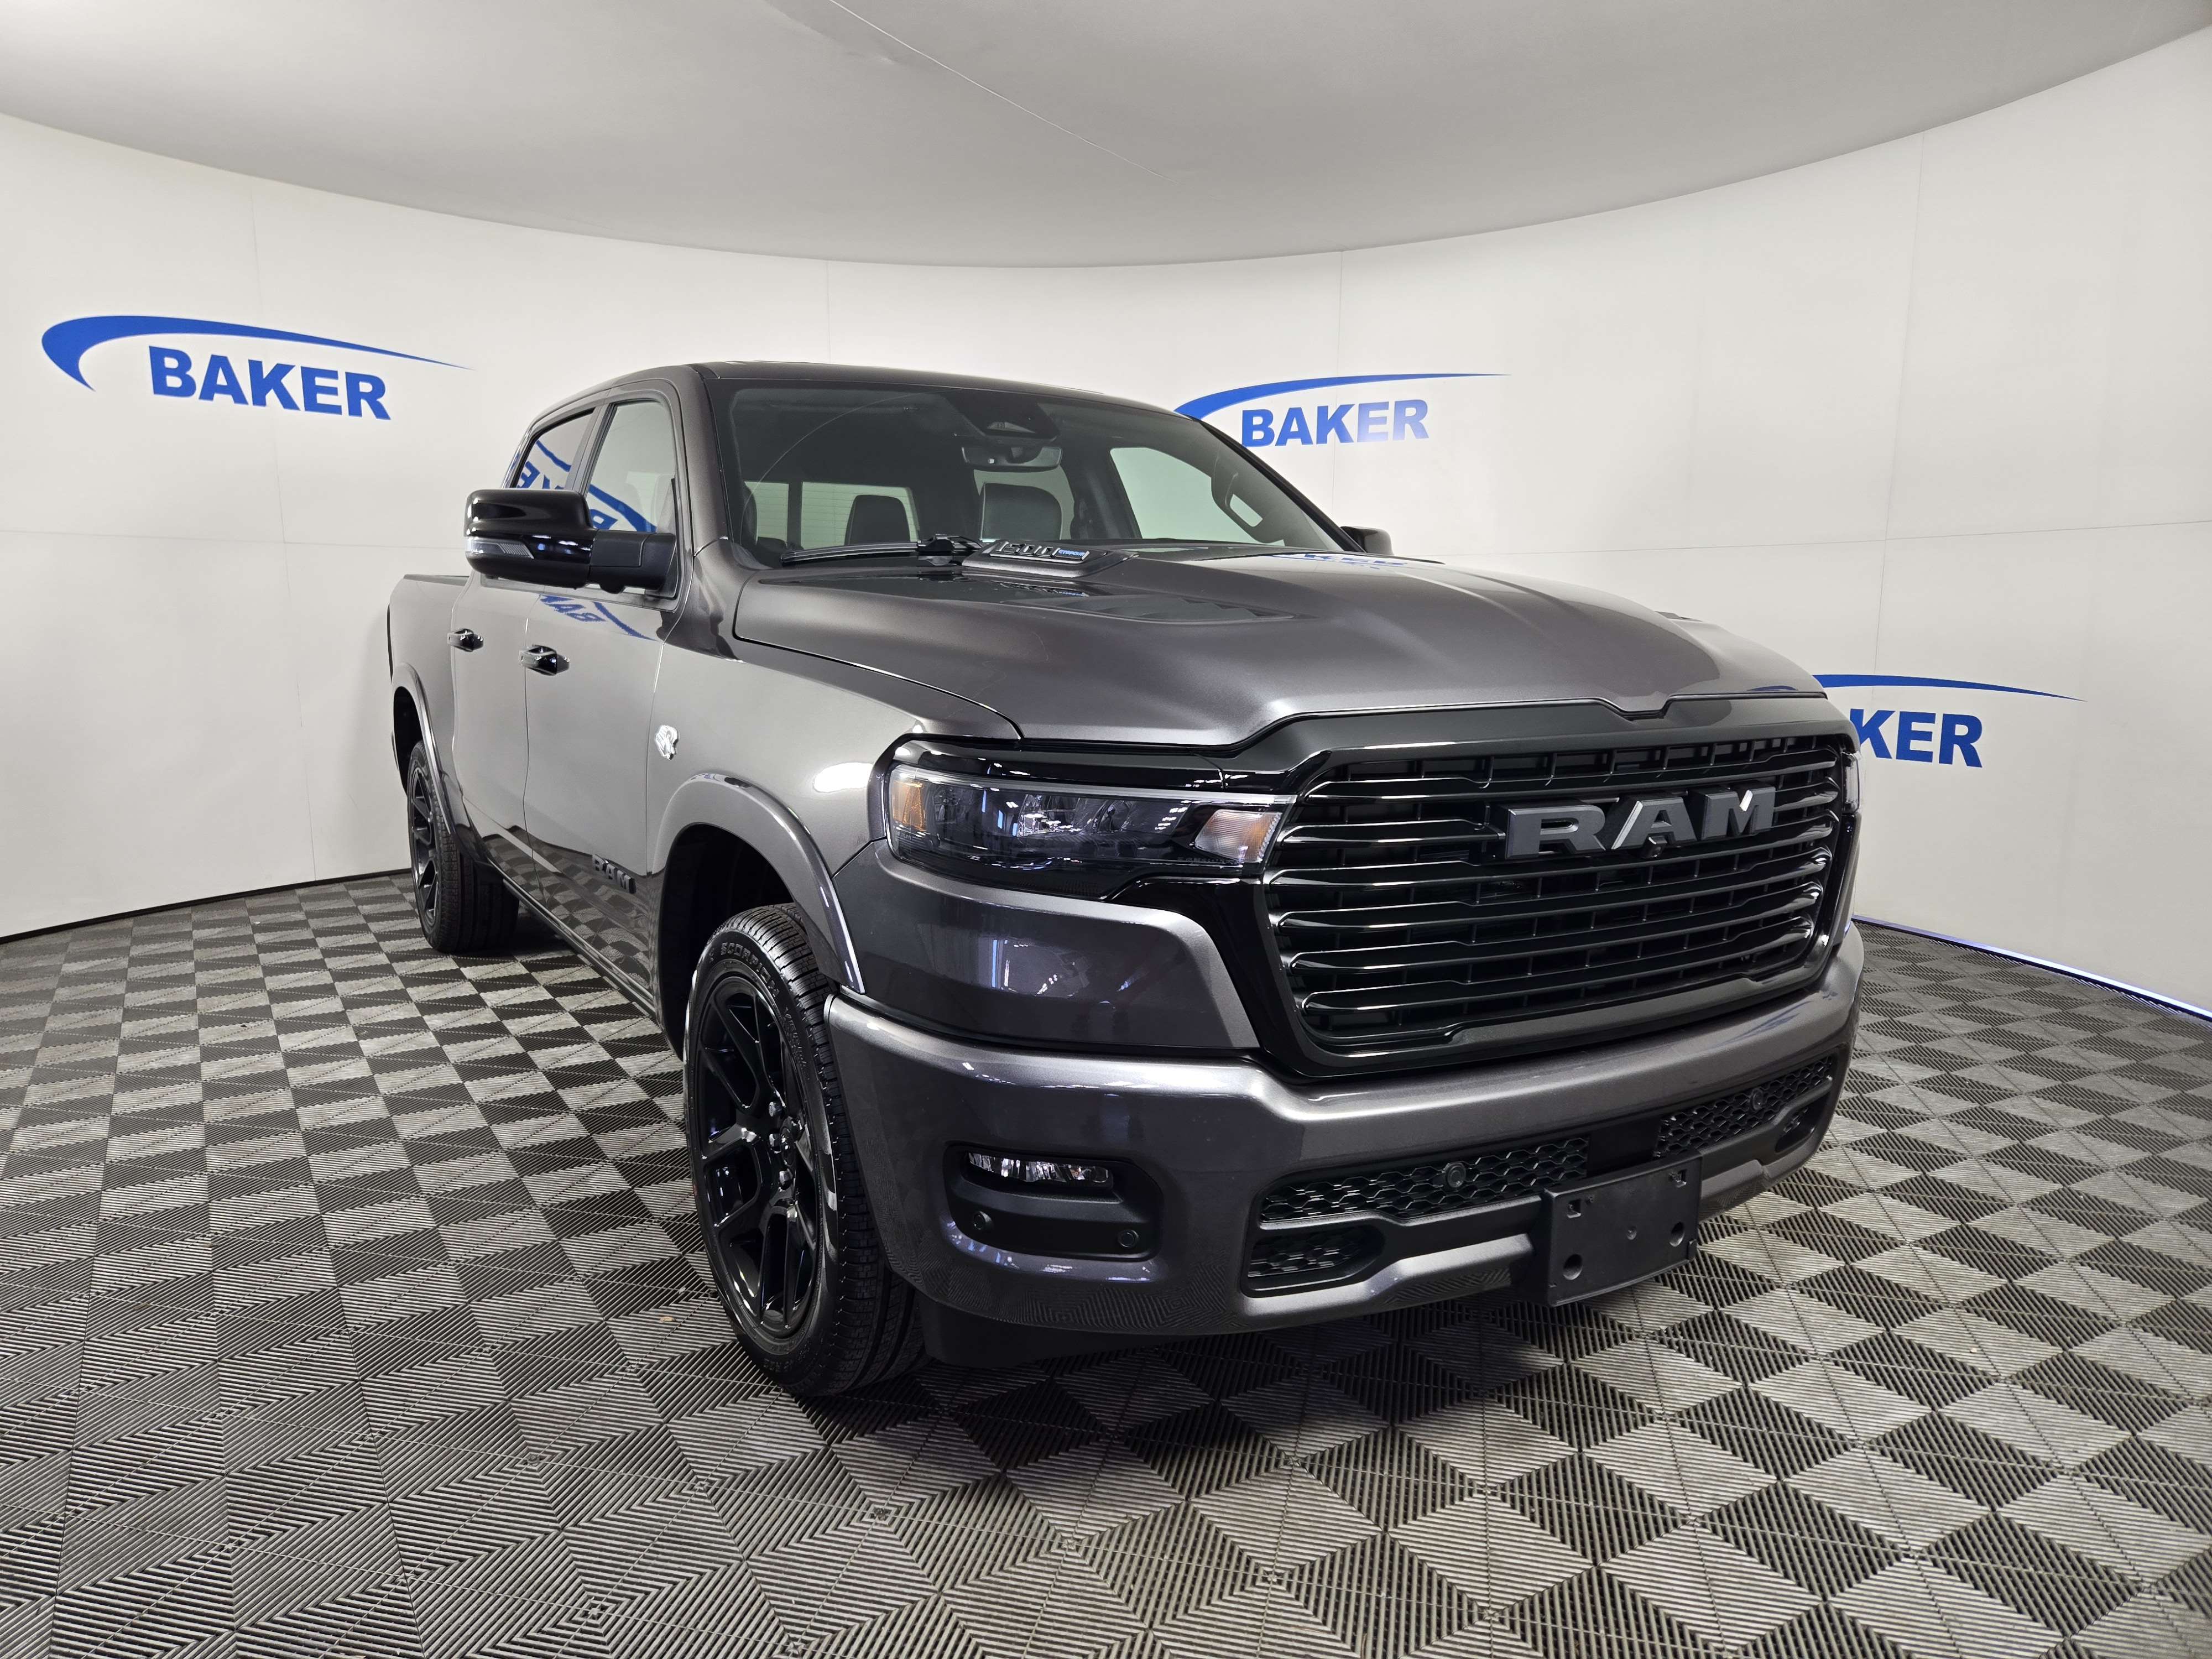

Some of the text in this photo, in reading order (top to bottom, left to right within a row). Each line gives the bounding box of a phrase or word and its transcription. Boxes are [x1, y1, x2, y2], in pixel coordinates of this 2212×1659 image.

[149, 346, 391, 420] BAKER
[1241, 399, 1430, 447] BAKER
[995, 540, 1061, 557] 1500
[1849, 708, 1983, 768] KER
[1504, 783, 1776, 859] RAM
[592, 853, 637, 894] RAM
